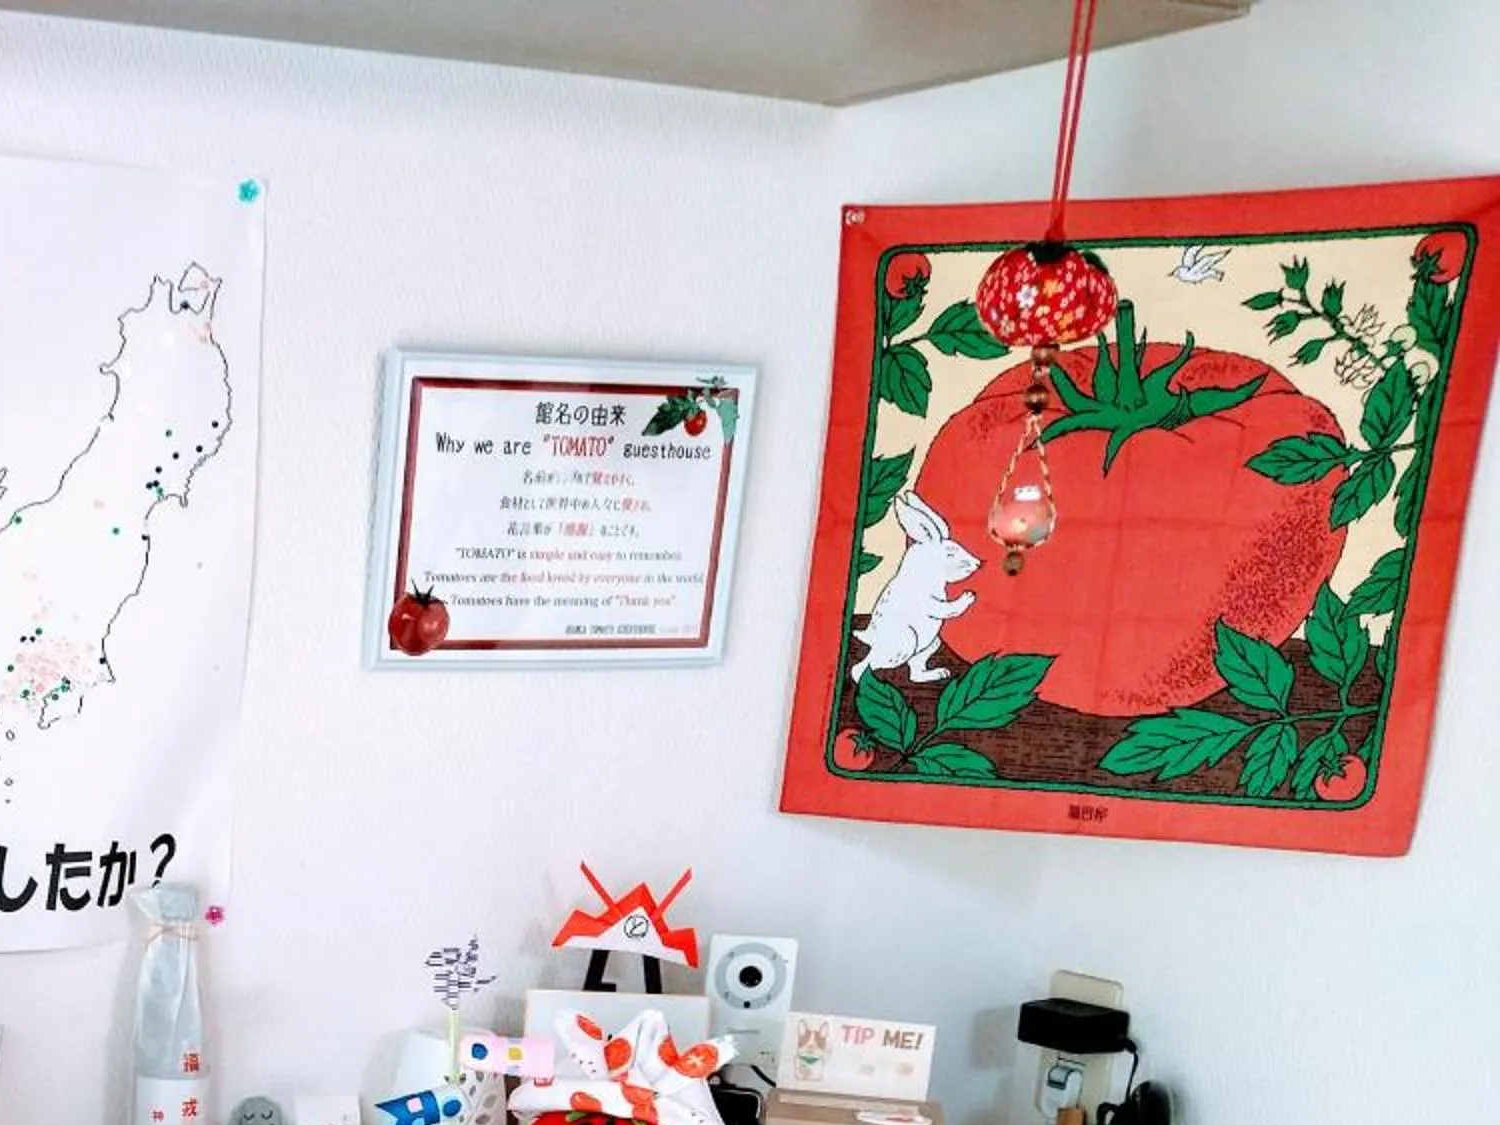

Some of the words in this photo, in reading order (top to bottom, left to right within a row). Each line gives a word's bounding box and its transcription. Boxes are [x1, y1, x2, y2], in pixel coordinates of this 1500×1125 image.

[535, 401, 626, 427] 館名の由来
[436, 432, 465, 453] Why
[474, 440, 494, 455] we
[503, 440, 532, 455] are
[542, 434, 615, 457] "TOMATO"
[623, 443, 712, 460] guesthouse
[841, 1025, 875, 1045] TIP
[881, 1029, 924, 1050] ME!
